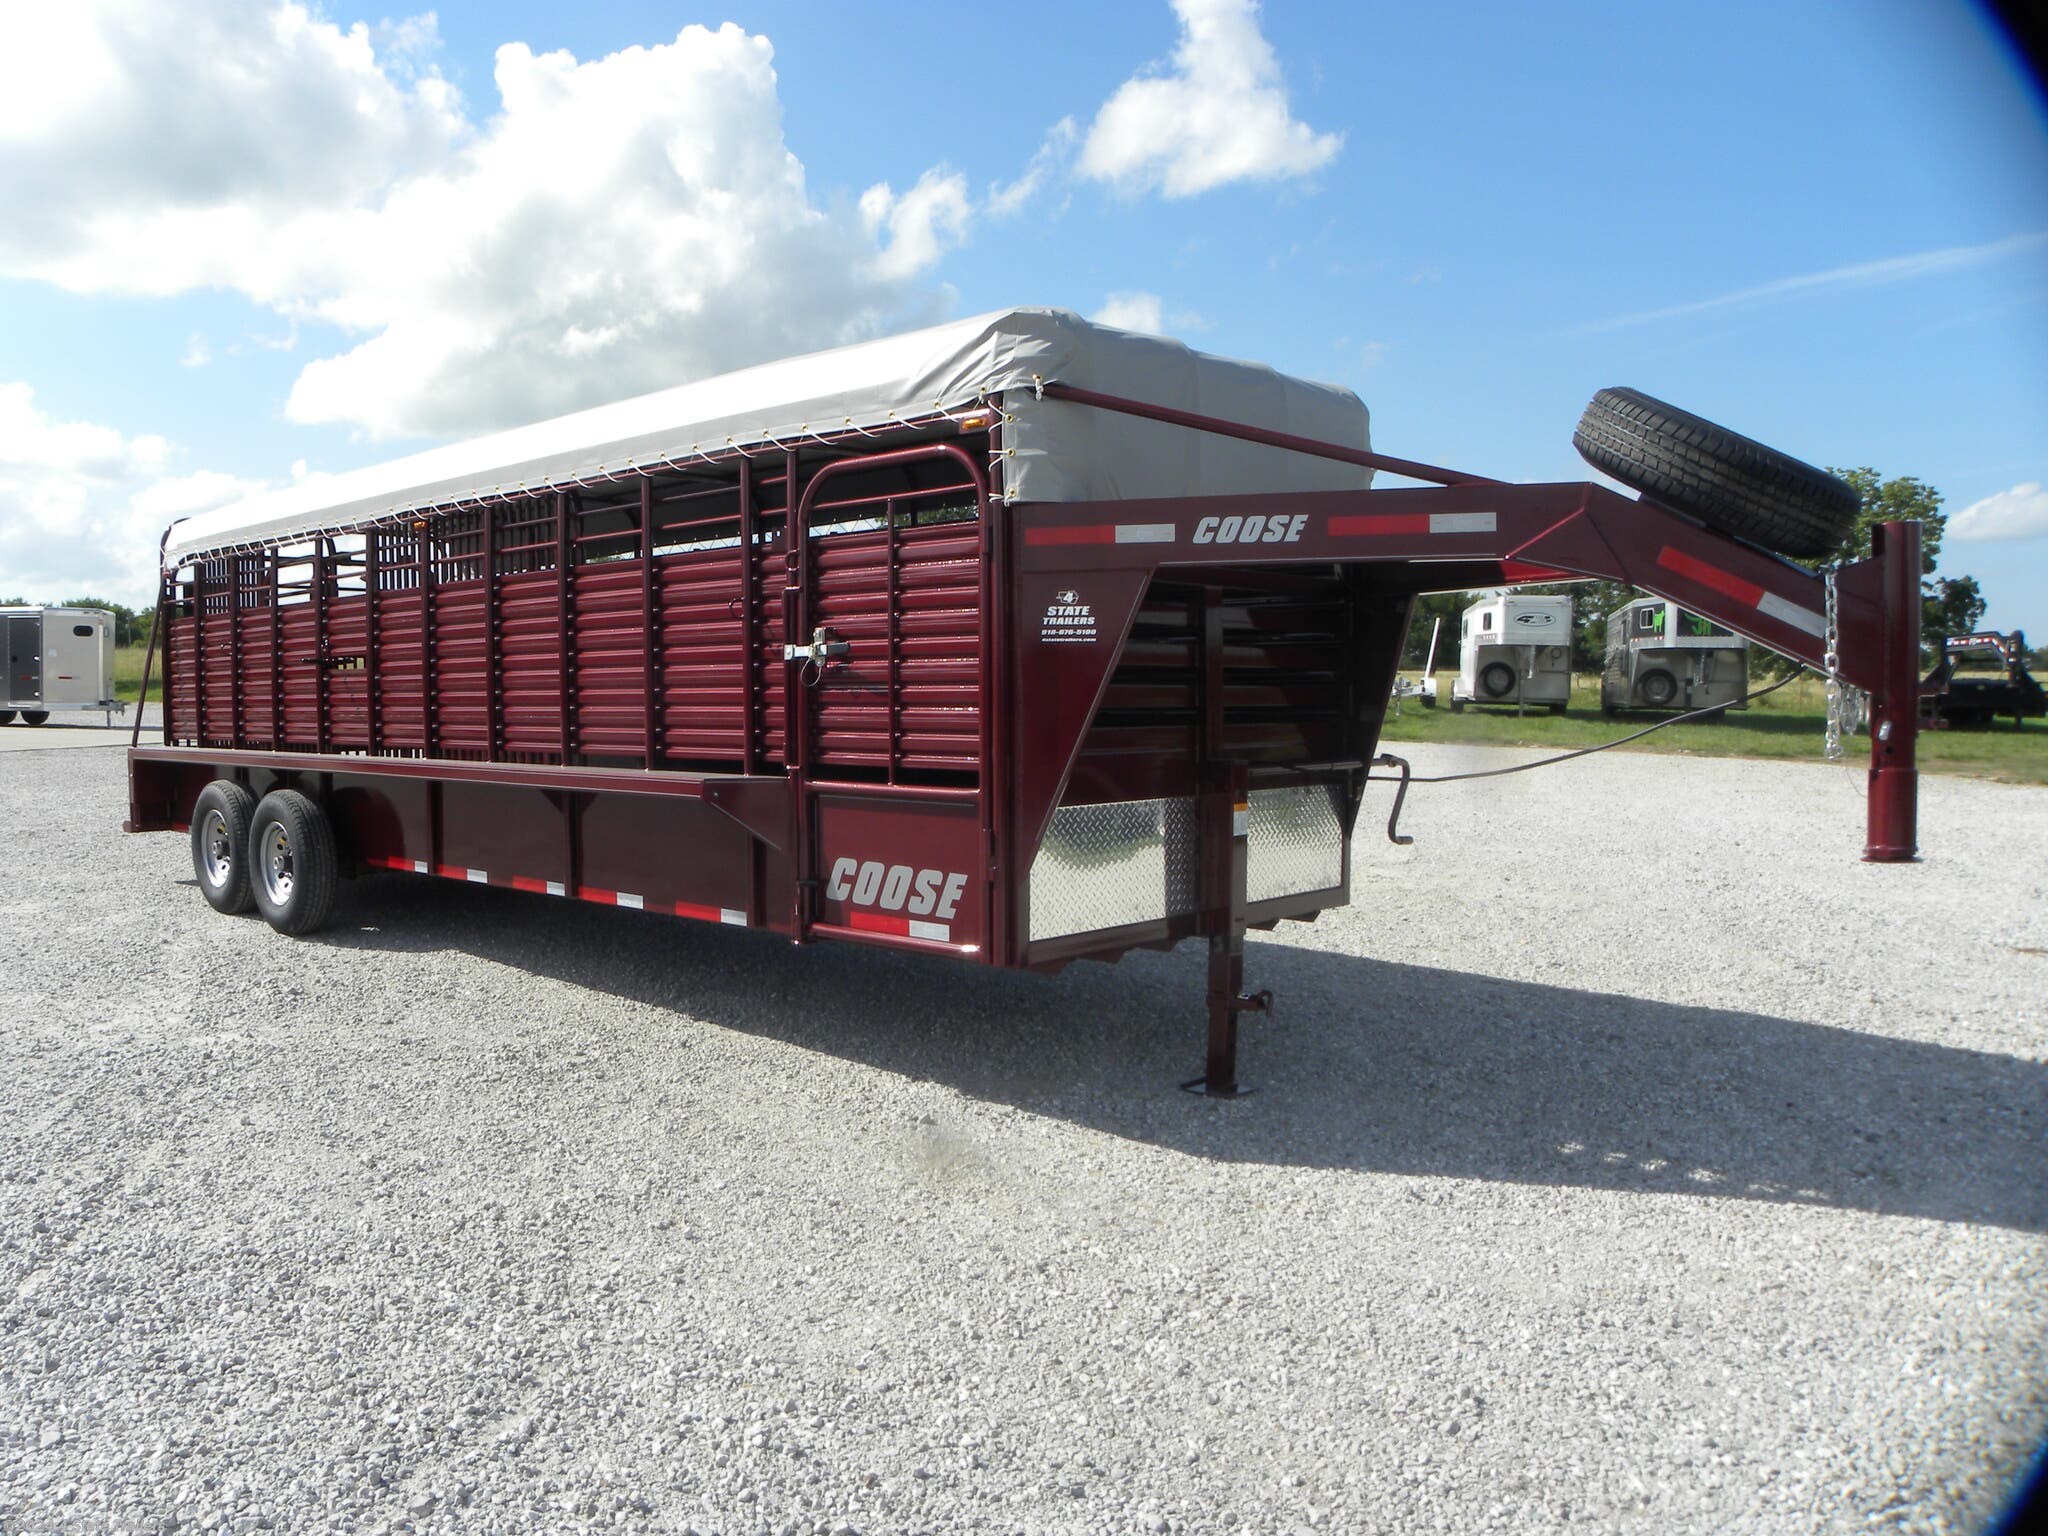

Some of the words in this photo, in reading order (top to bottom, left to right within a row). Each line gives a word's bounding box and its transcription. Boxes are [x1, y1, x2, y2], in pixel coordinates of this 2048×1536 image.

[1192, 514, 1309, 544] COOSE
[1063, 591, 1073, 603] 4
[1047, 606, 1090, 616] STATE
[1043, 617, 1096, 625] TRAILERS
[826, 857, 968, 919] COOSE
